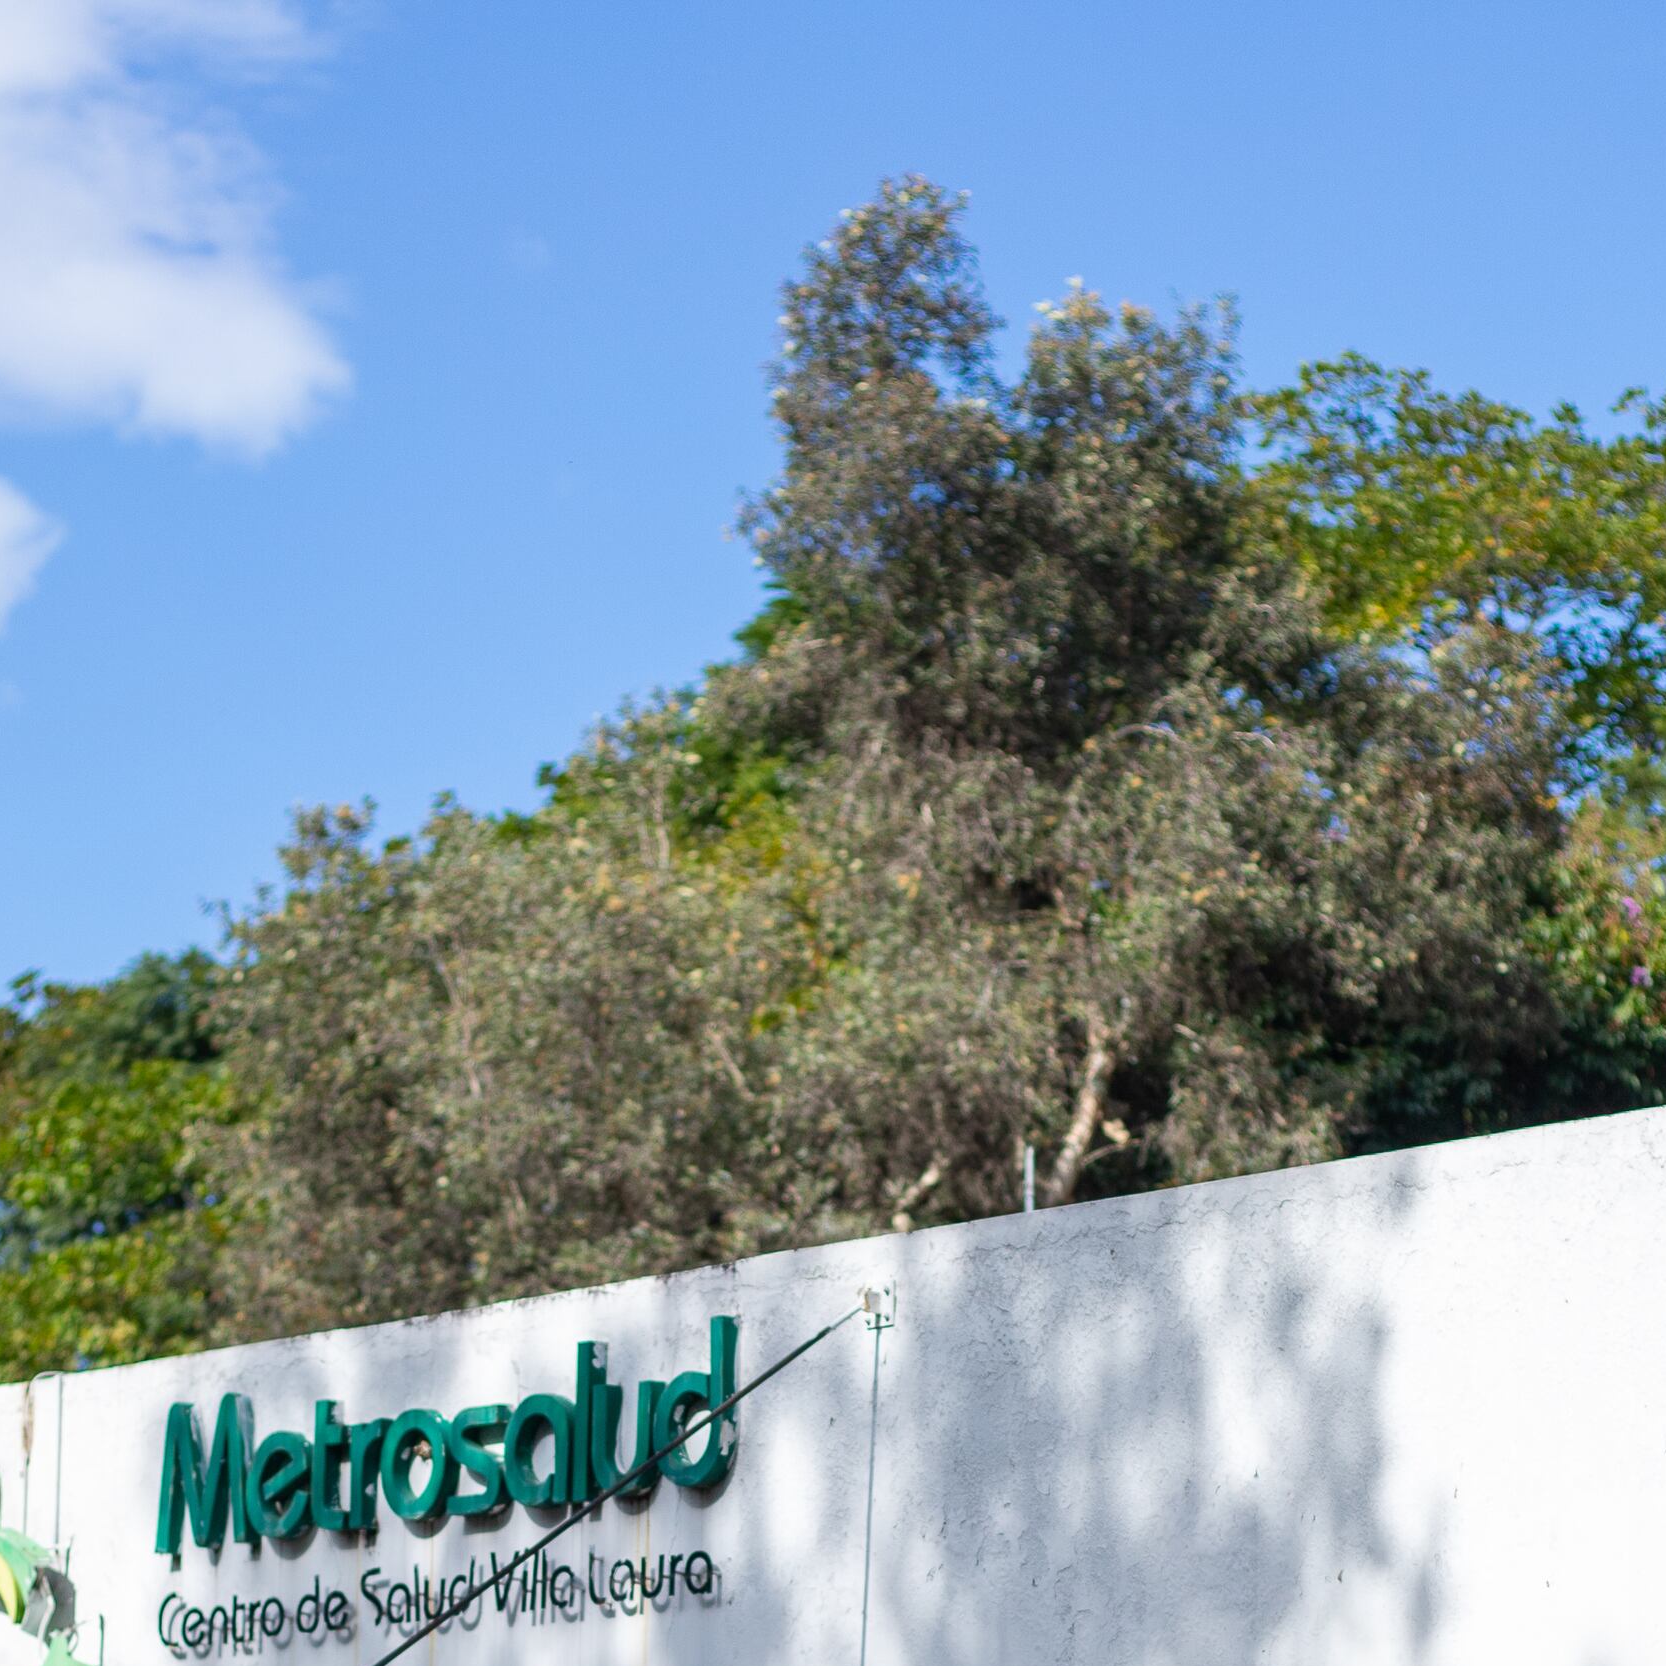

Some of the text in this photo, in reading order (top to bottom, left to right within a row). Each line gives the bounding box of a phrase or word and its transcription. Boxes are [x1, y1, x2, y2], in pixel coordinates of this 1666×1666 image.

[155, 1315, 738, 1554] Metrosalud
[158, 1547, 714, 1647] Centro de Salud Villa Laura
